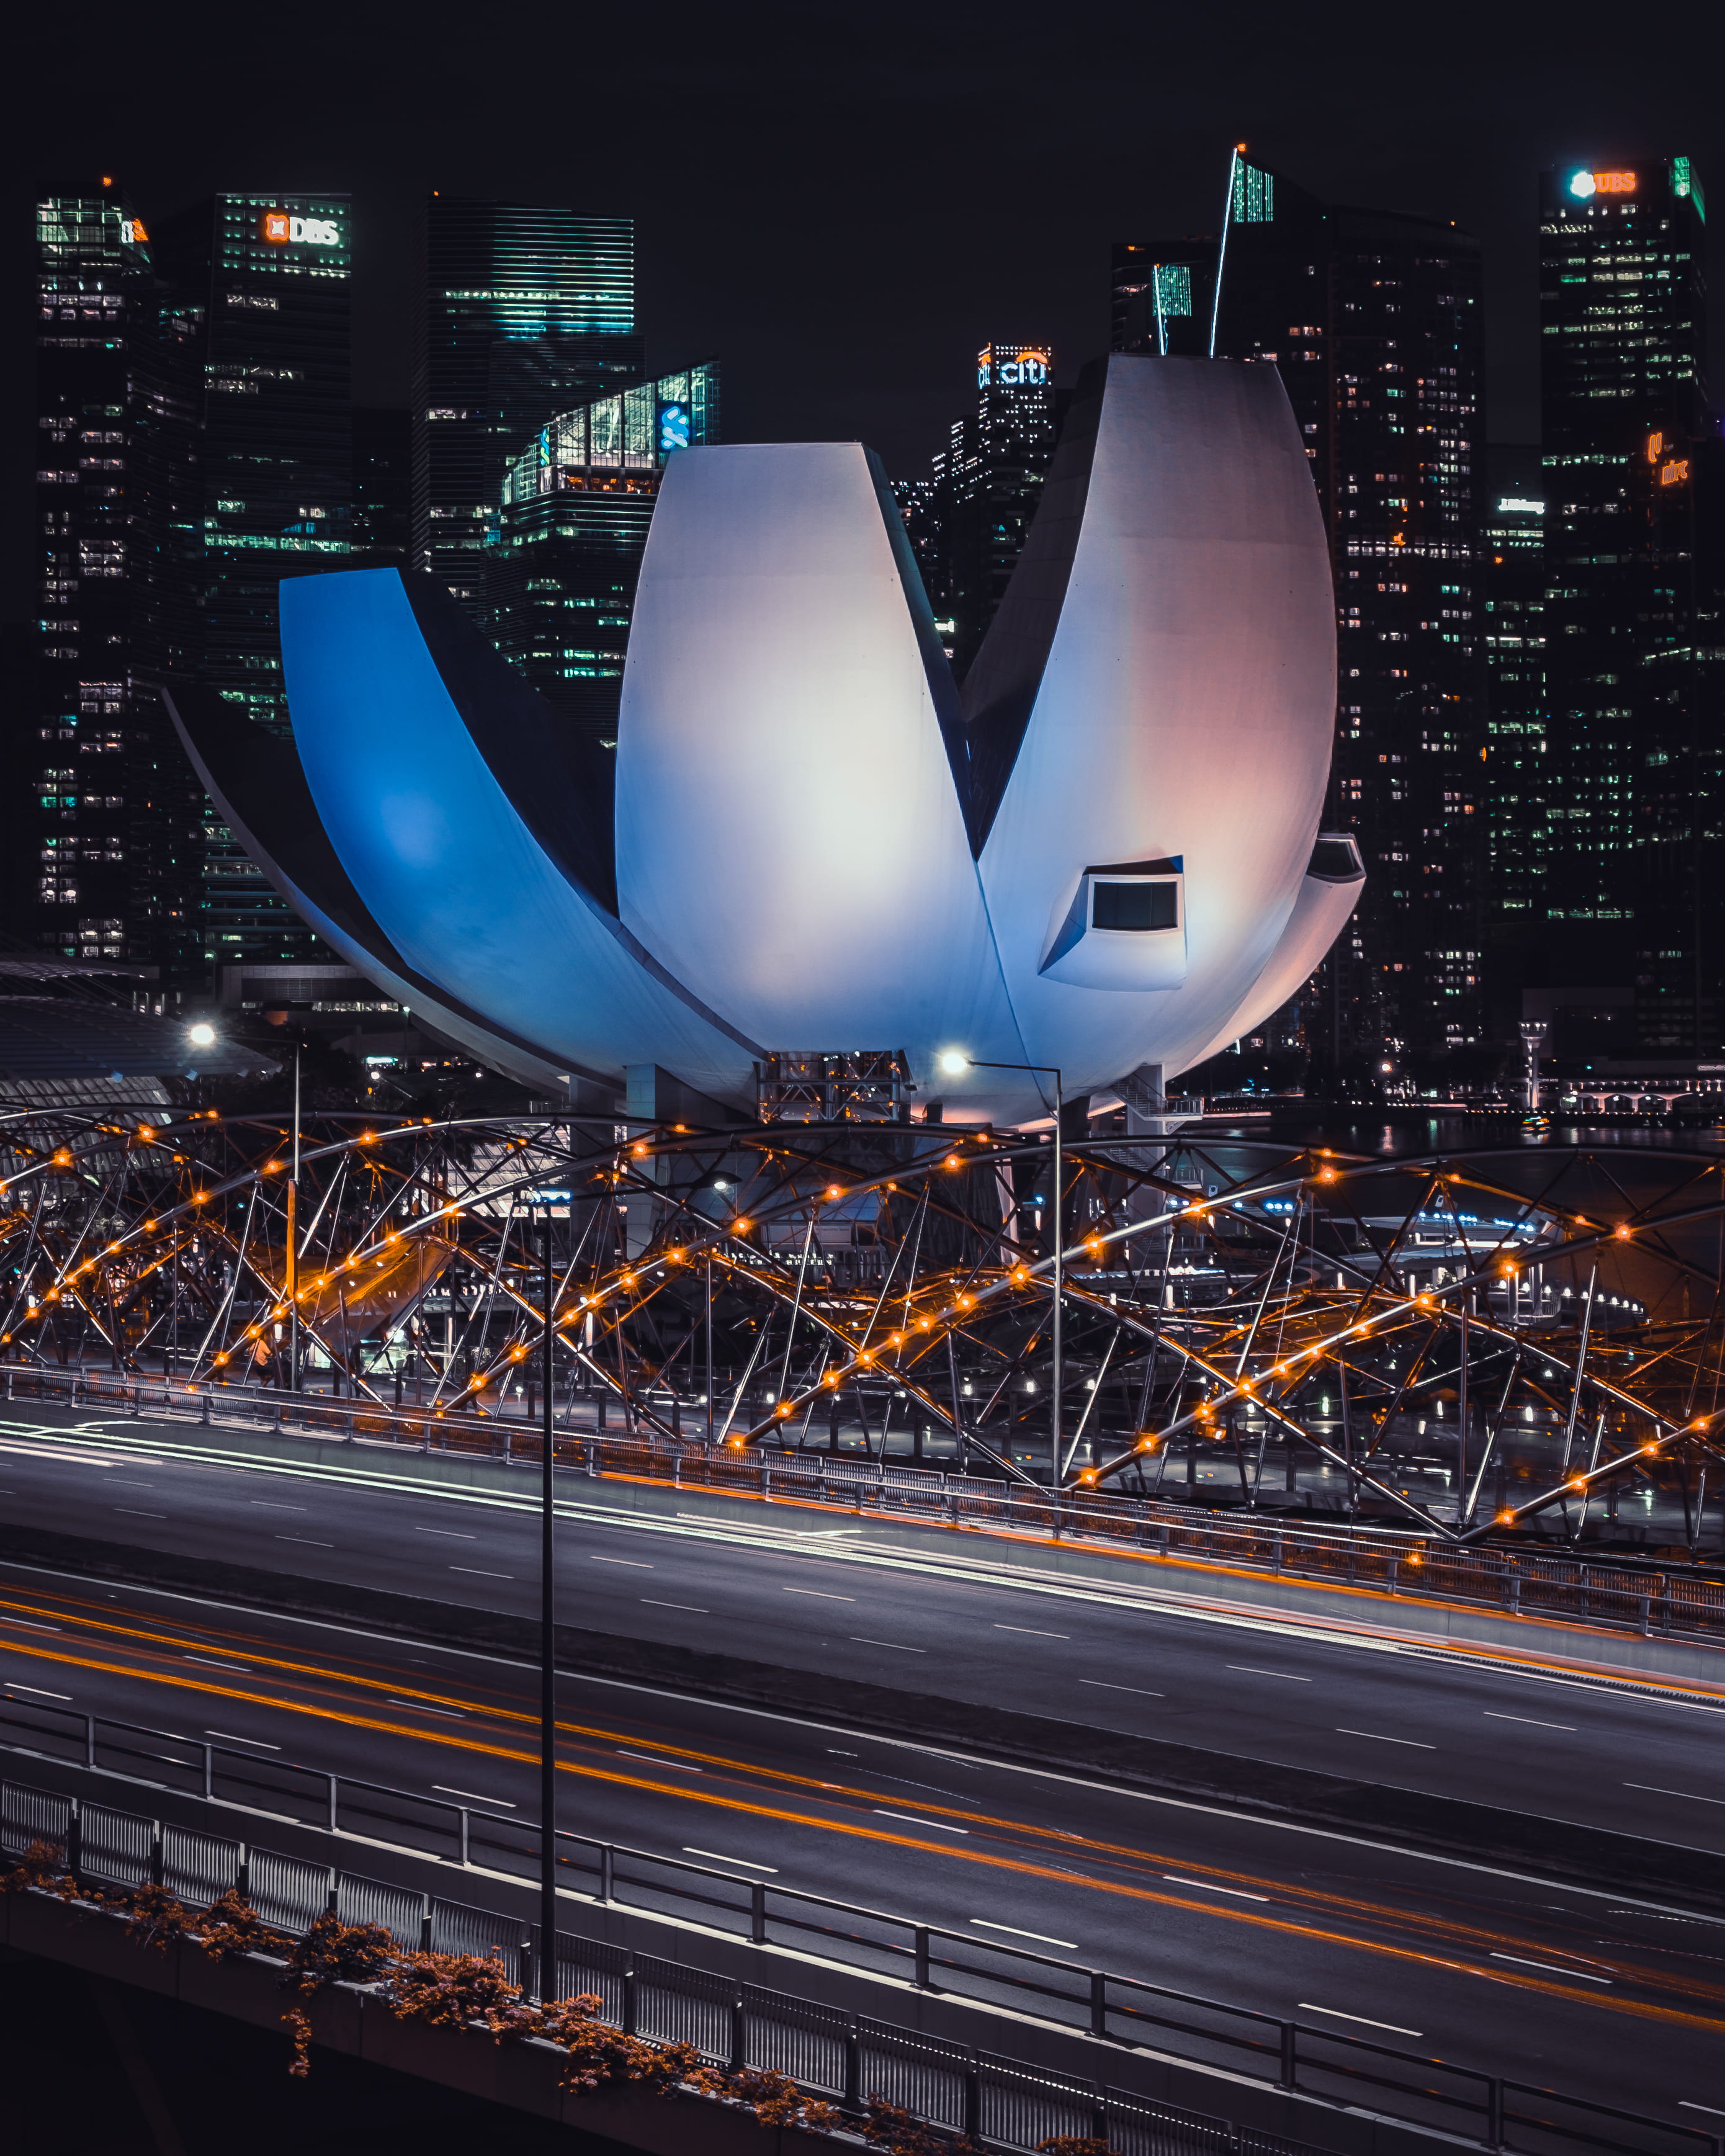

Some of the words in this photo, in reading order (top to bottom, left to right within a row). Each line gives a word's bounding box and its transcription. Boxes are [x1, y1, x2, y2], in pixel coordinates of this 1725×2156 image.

[1595, 173, 1635, 192] UBS
[289, 217, 339, 245] DBS
[1001, 359, 1047, 384] citi
